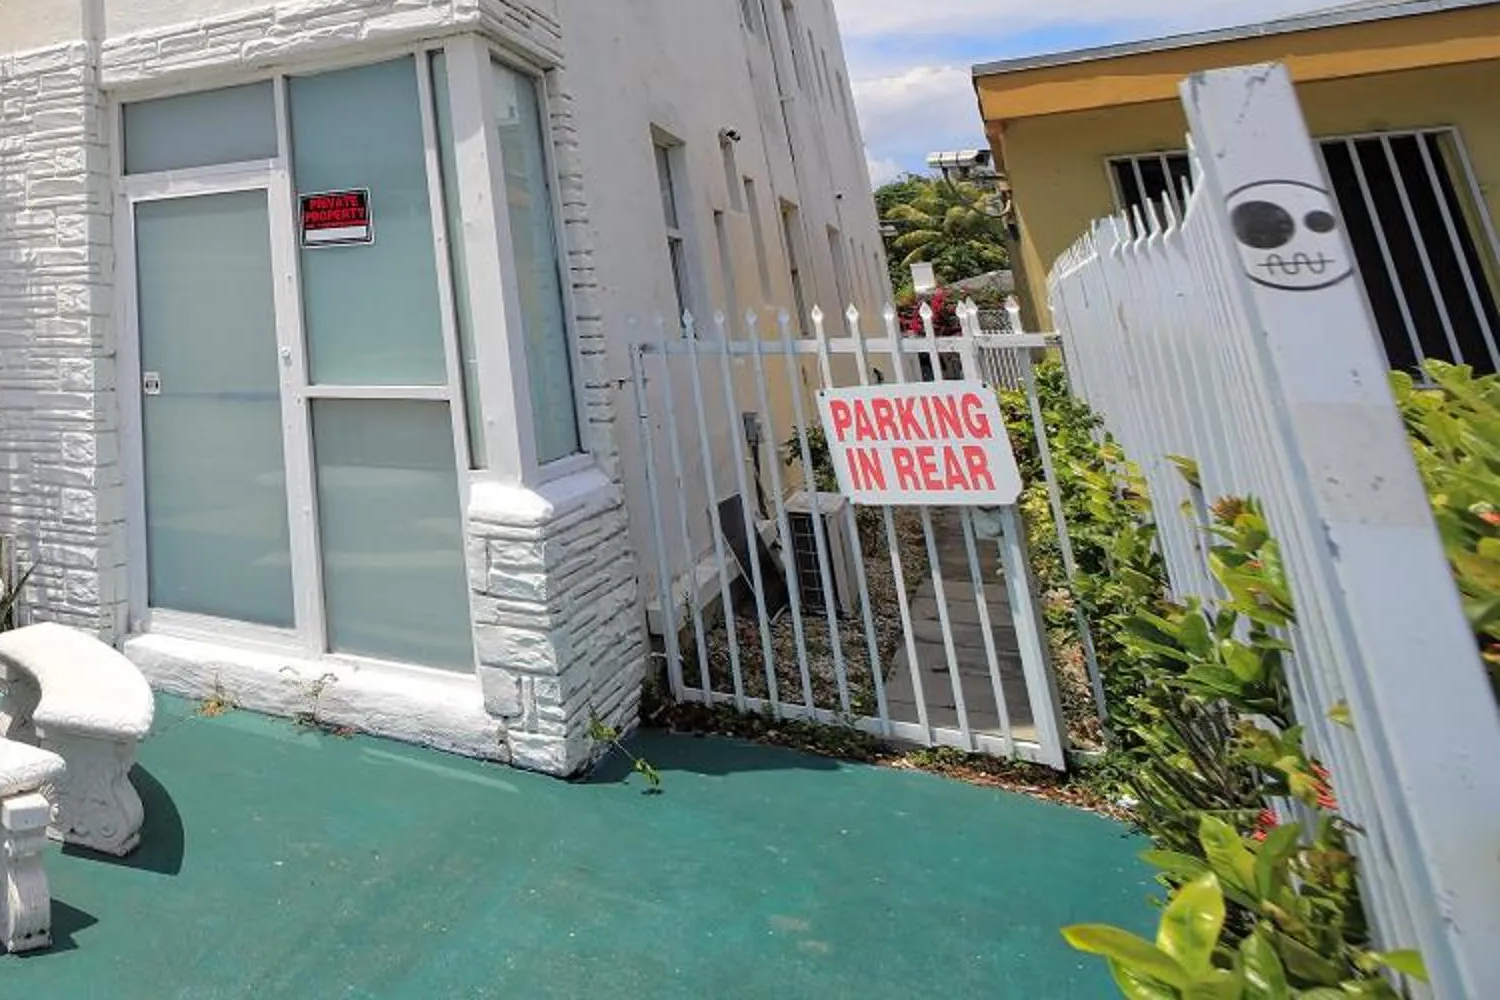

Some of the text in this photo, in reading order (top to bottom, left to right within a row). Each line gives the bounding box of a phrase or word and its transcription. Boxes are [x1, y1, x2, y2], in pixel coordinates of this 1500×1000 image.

[305, 207, 366, 222] PROPERTY
[308, 195, 360, 210] PRIVATE
[828, 392, 992, 442] PARKING
[845, 445, 997, 491] IN REAR
